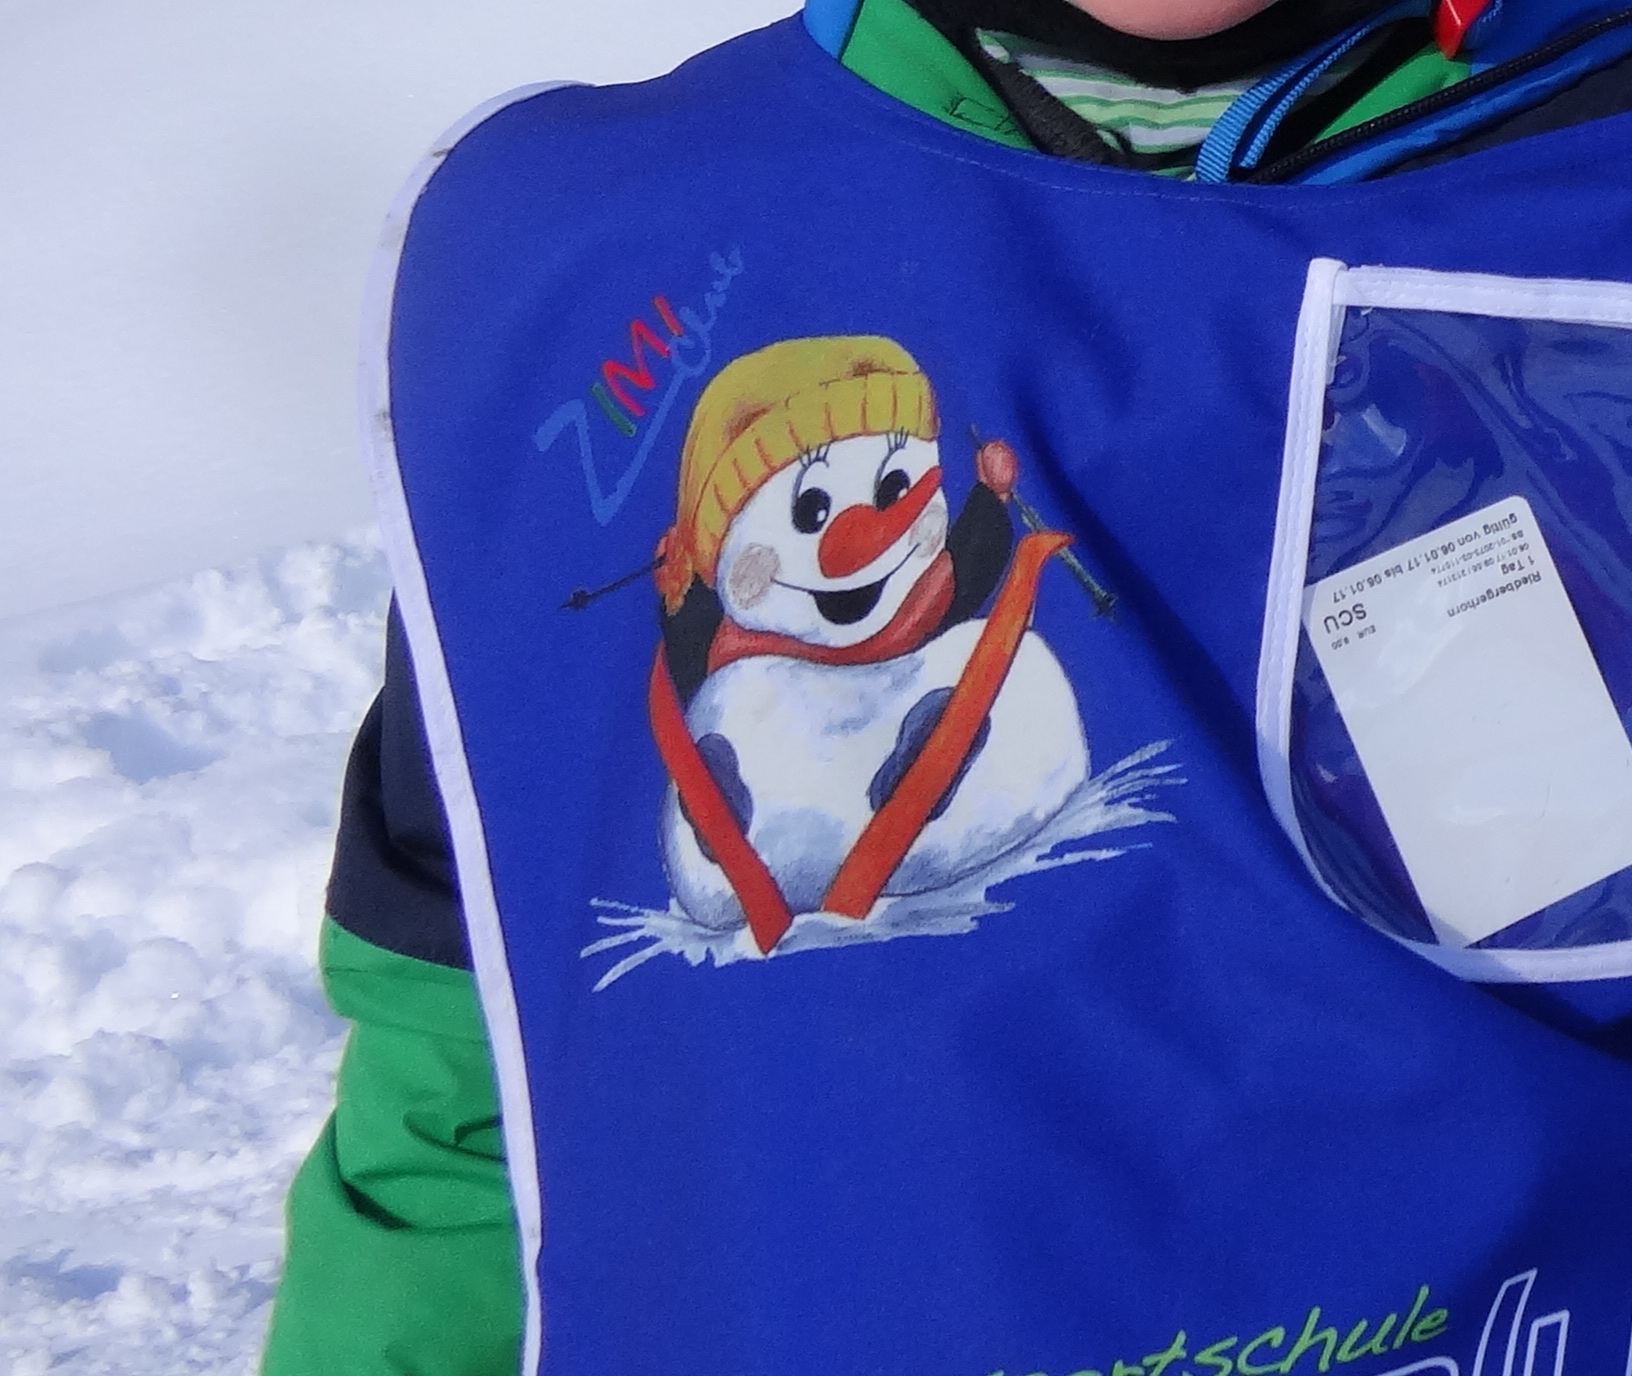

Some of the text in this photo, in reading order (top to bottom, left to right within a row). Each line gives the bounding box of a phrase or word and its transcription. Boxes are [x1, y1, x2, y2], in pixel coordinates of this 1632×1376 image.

[1482, 513, 1517, 535] gültig
[1457, 531, 1481, 546] von
[1384, 564, 1404, 578] bis
[1501, 559, 1525, 575] Tag
[1447, 570, 1542, 617] Riedbergerhorn
[1323, 603, 1367, 634] SCU
[1357, 625, 1376, 639] EUR
